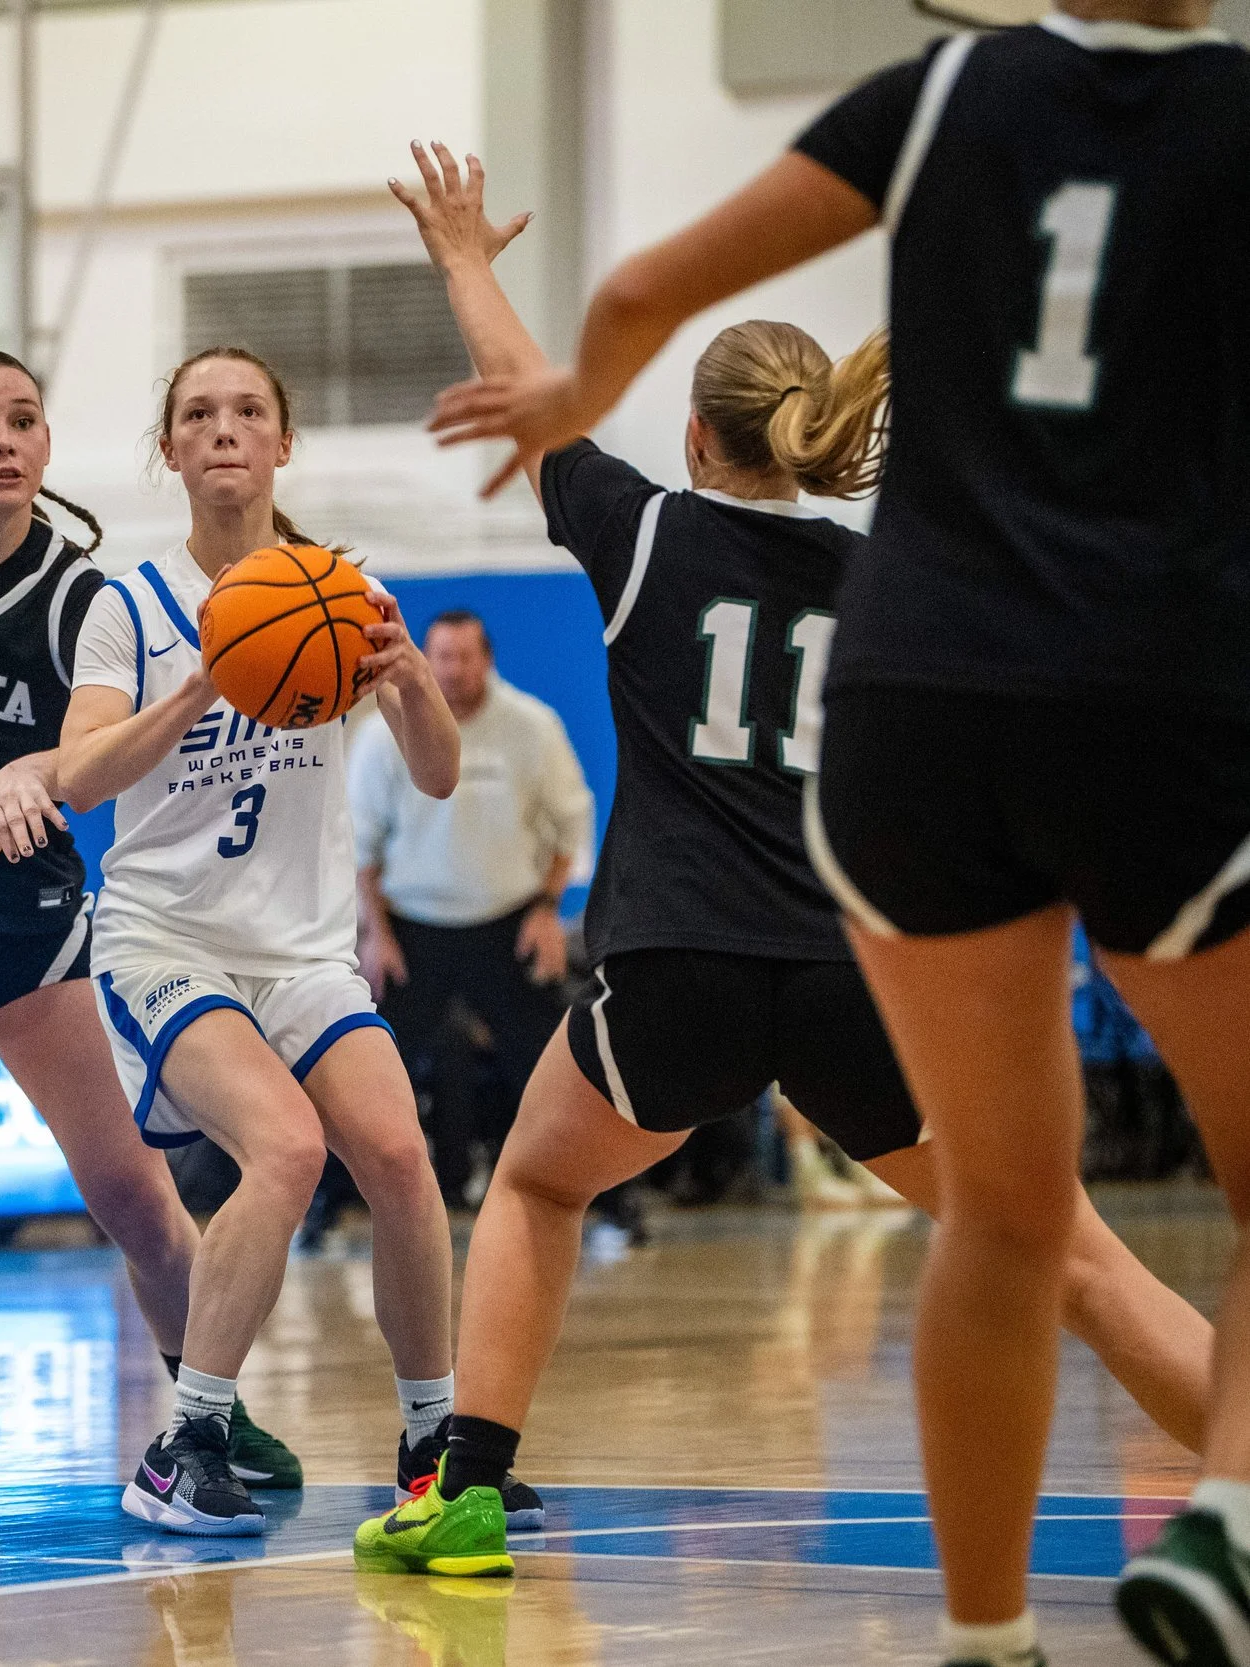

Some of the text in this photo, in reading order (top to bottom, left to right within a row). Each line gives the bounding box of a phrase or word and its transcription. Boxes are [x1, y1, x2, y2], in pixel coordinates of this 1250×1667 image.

[1011, 180, 1115, 407] 1
[687, 597, 837, 775] 11
[179, 708, 274, 755] SM
[168, 755, 324, 794] BASKETBALL
[188, 738, 304, 773] WOMEN'S
[217, 783, 267, 859] 3
[145, 974, 191, 1010] SMC
